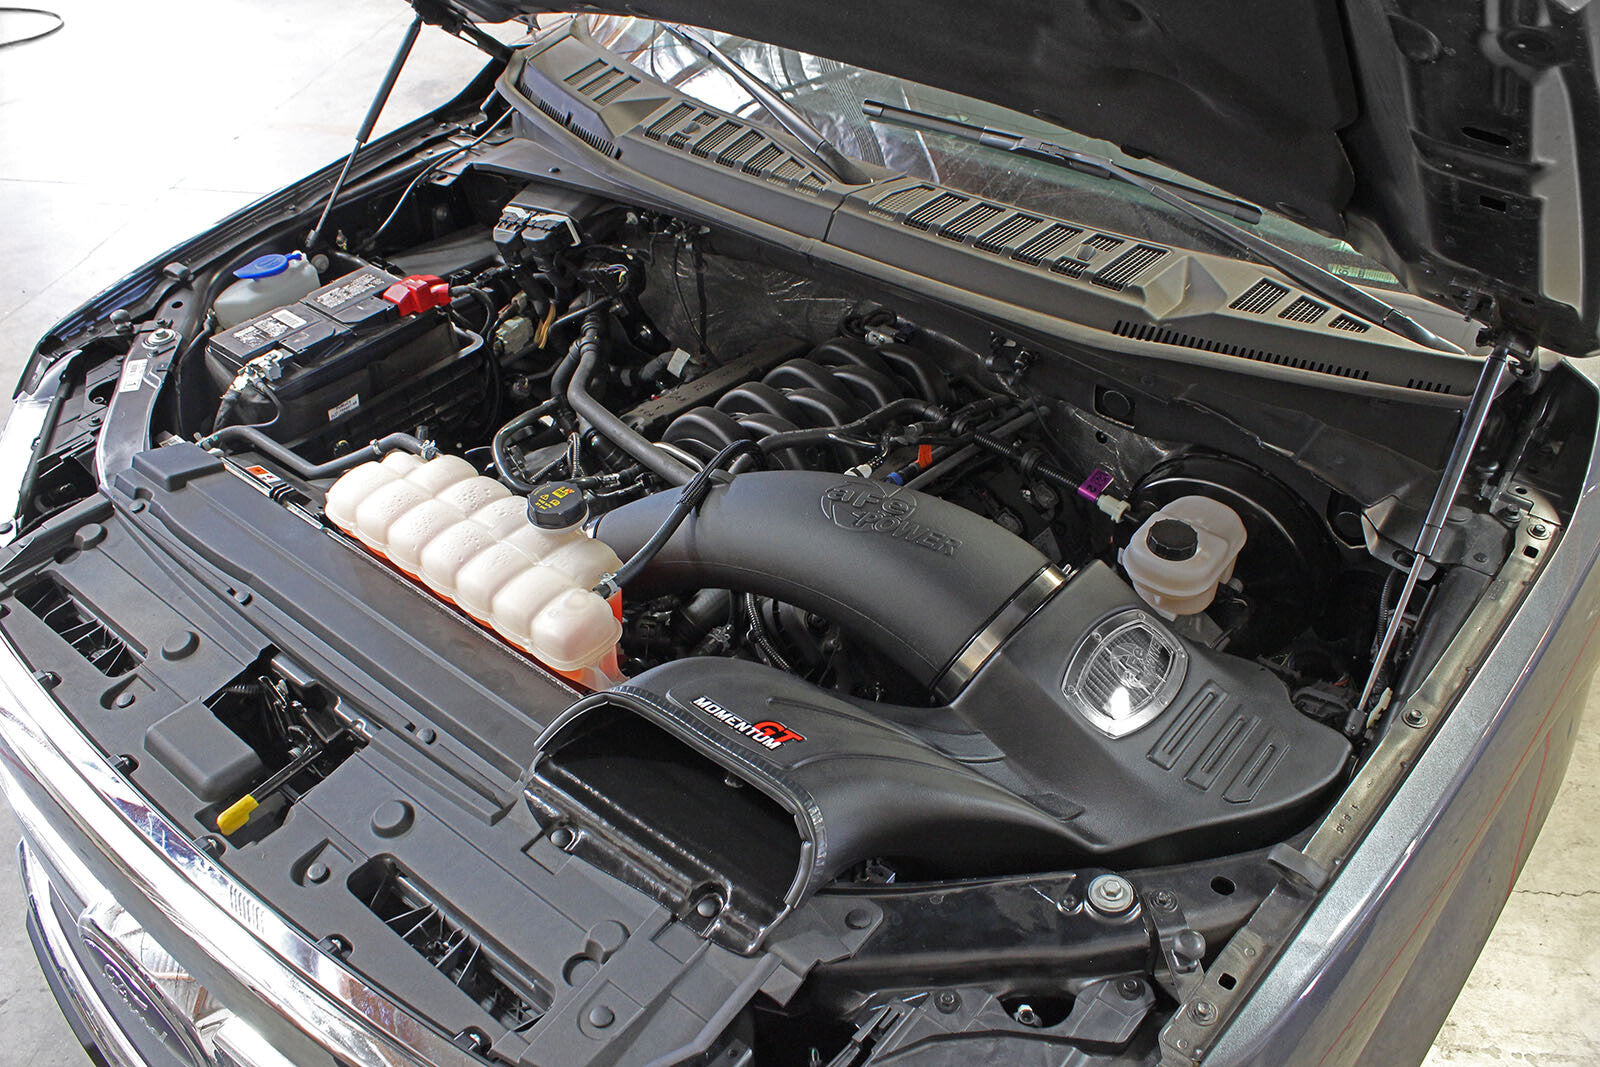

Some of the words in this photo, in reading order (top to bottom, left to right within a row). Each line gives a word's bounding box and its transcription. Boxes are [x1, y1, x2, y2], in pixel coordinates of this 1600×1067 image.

[851, 510, 963, 556] POWER
[693, 697, 782, 750] MOMENTUM
[752, 721, 804, 744] GT
